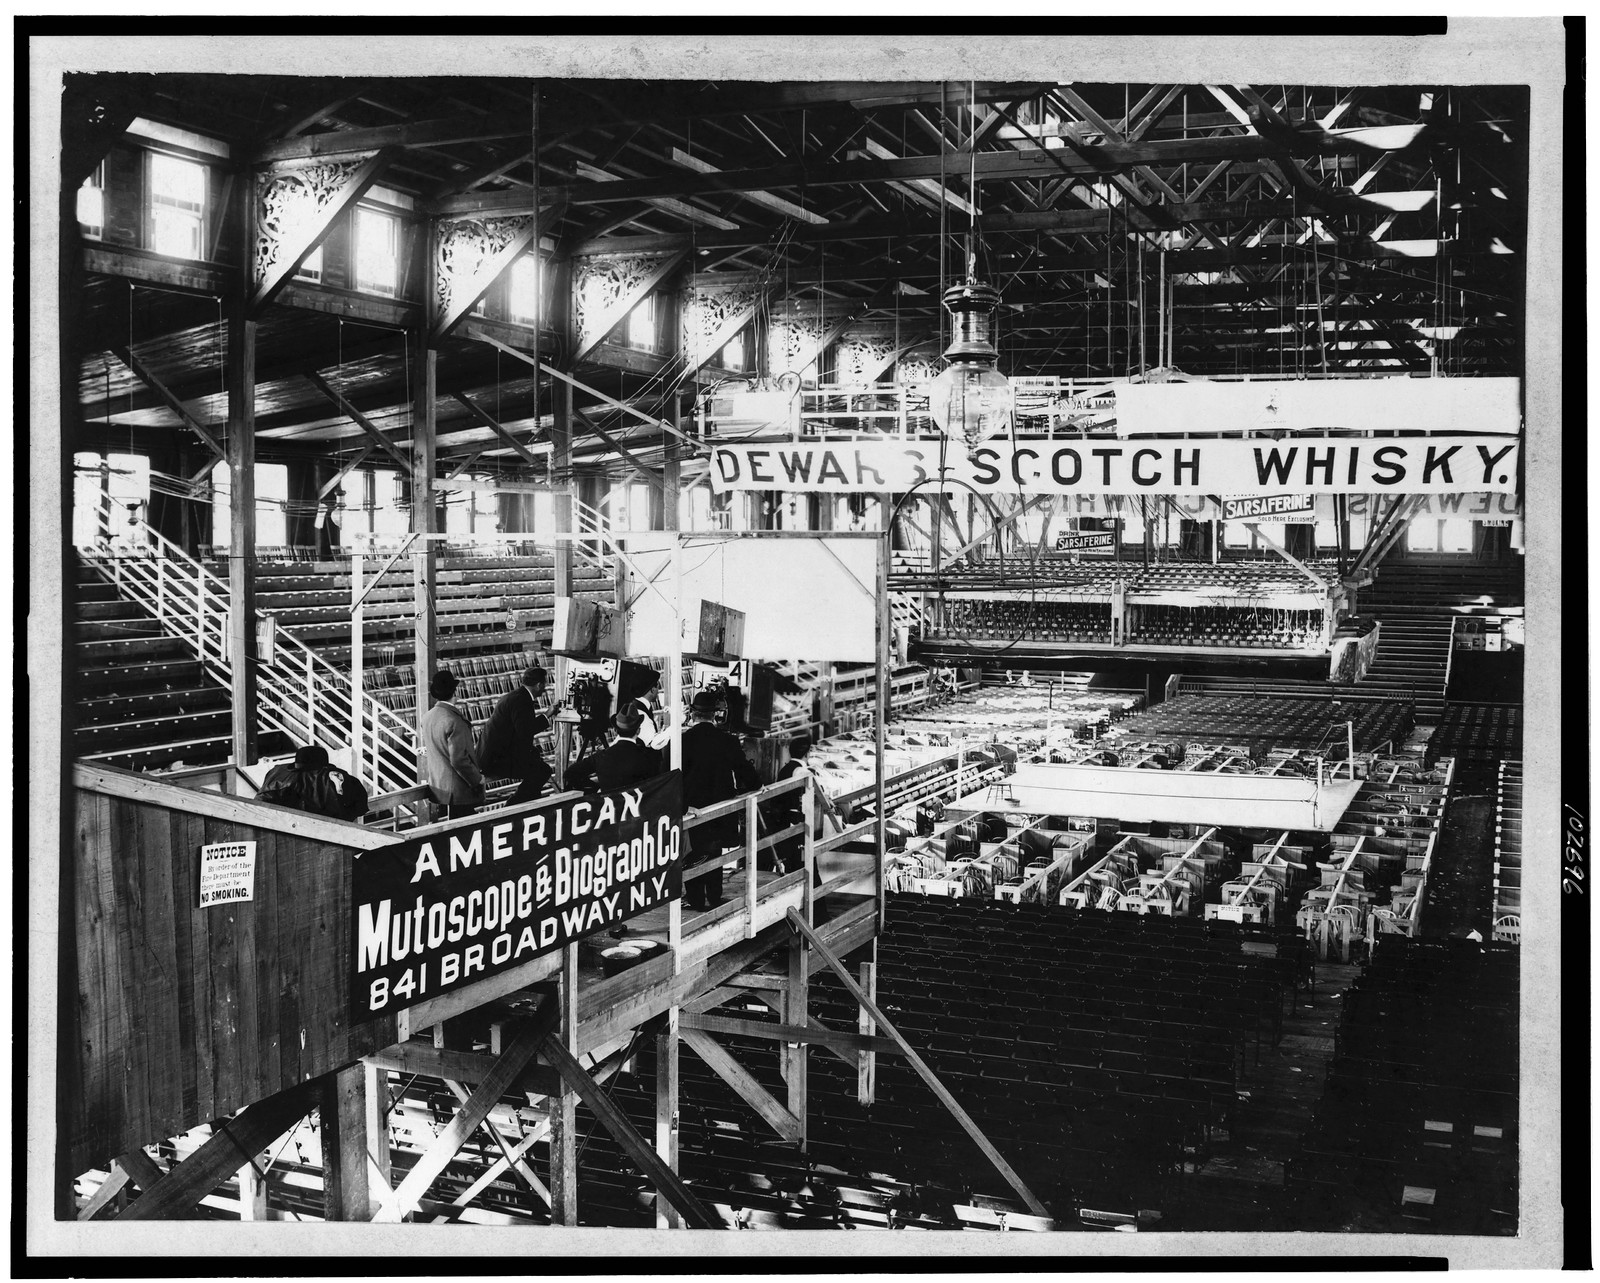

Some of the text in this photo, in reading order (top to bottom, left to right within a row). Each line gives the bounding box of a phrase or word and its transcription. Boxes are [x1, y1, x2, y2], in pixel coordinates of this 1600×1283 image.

[972, 448, 1201, 486] SCOTCH
[1253, 445, 1516, 486] WHISKY.
[1225, 494, 1312, 519] SARSAFERINE
[1058, 535, 1113, 550] SARSAFERINE
[729, 661, 742, 686] 4
[410, 788, 644, 883] AMERICAN
[206, 845, 247, 861] NOTICE
[201, 887, 249, 904] NO SMOKING.
[358, 874, 532, 973] Mutoscope
[555, 821, 655, 907] Biograph
[657, 815, 681, 866] Co
[369, 871, 669, 1011] 841 BROADWAY, N.Y.
